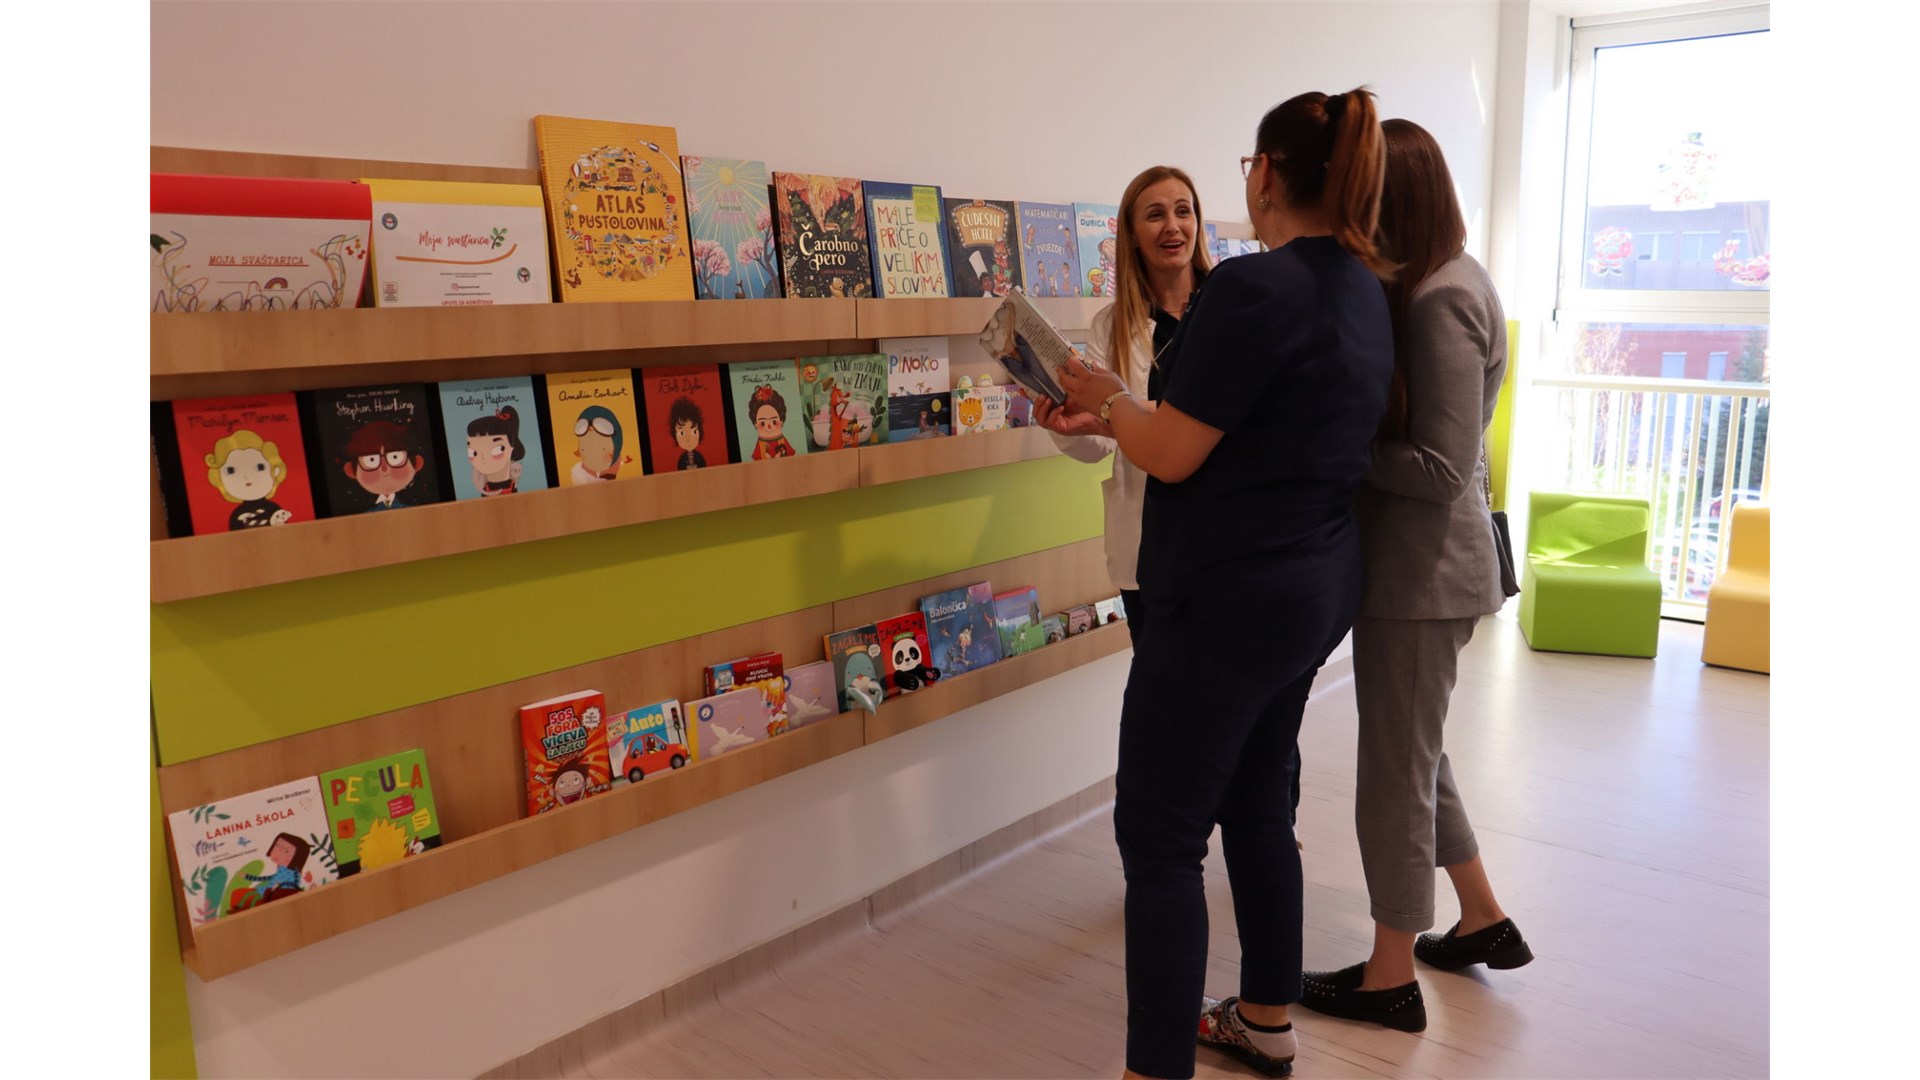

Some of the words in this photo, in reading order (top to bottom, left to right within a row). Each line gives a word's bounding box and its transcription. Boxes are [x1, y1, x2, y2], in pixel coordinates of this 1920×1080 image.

[596, 194, 646, 214] ATLAS
[579, 215, 666, 231] PUSTOLOVINA
[877, 206, 915, 225] MALE
[961, 211, 1000, 228] ČUDESNI
[418, 230, 444, 252] Moja
[799, 223, 858, 260] Čarobno
[880, 227, 916, 250] PRIČE
[919, 231, 929, 248] O
[970, 227, 994, 241] HOTEL
[209, 255, 236, 266] MOJA
[241, 253, 305, 266] SVAŠTARICA
[809, 251, 846, 271] pero
[884, 251, 939, 275] VELIKIM
[887, 275, 945, 295] SLOVIMA
[659, 379, 679, 393] Bob
[741, 374, 763, 384] Frida
[763, 372, 786, 382] Kahlo
[558, 389, 592, 402] Amelia
[593, 386, 628, 398] Earhart
[336, 401, 372, 420] Stephen
[374, 397, 415, 416] Hawking
[187, 412, 244, 433] Marilyn
[929, 601, 967, 619] Balončica
[831, 633, 864, 656] ZAGRLI
[865, 632, 878, 645] ME
[547, 718, 580, 738] FORA
[629, 713, 664, 733] Auto
[543, 727, 587, 750] VICEVA
[206, 820, 253, 840] LANINA
[255, 808, 296, 826] ŠKOLA
